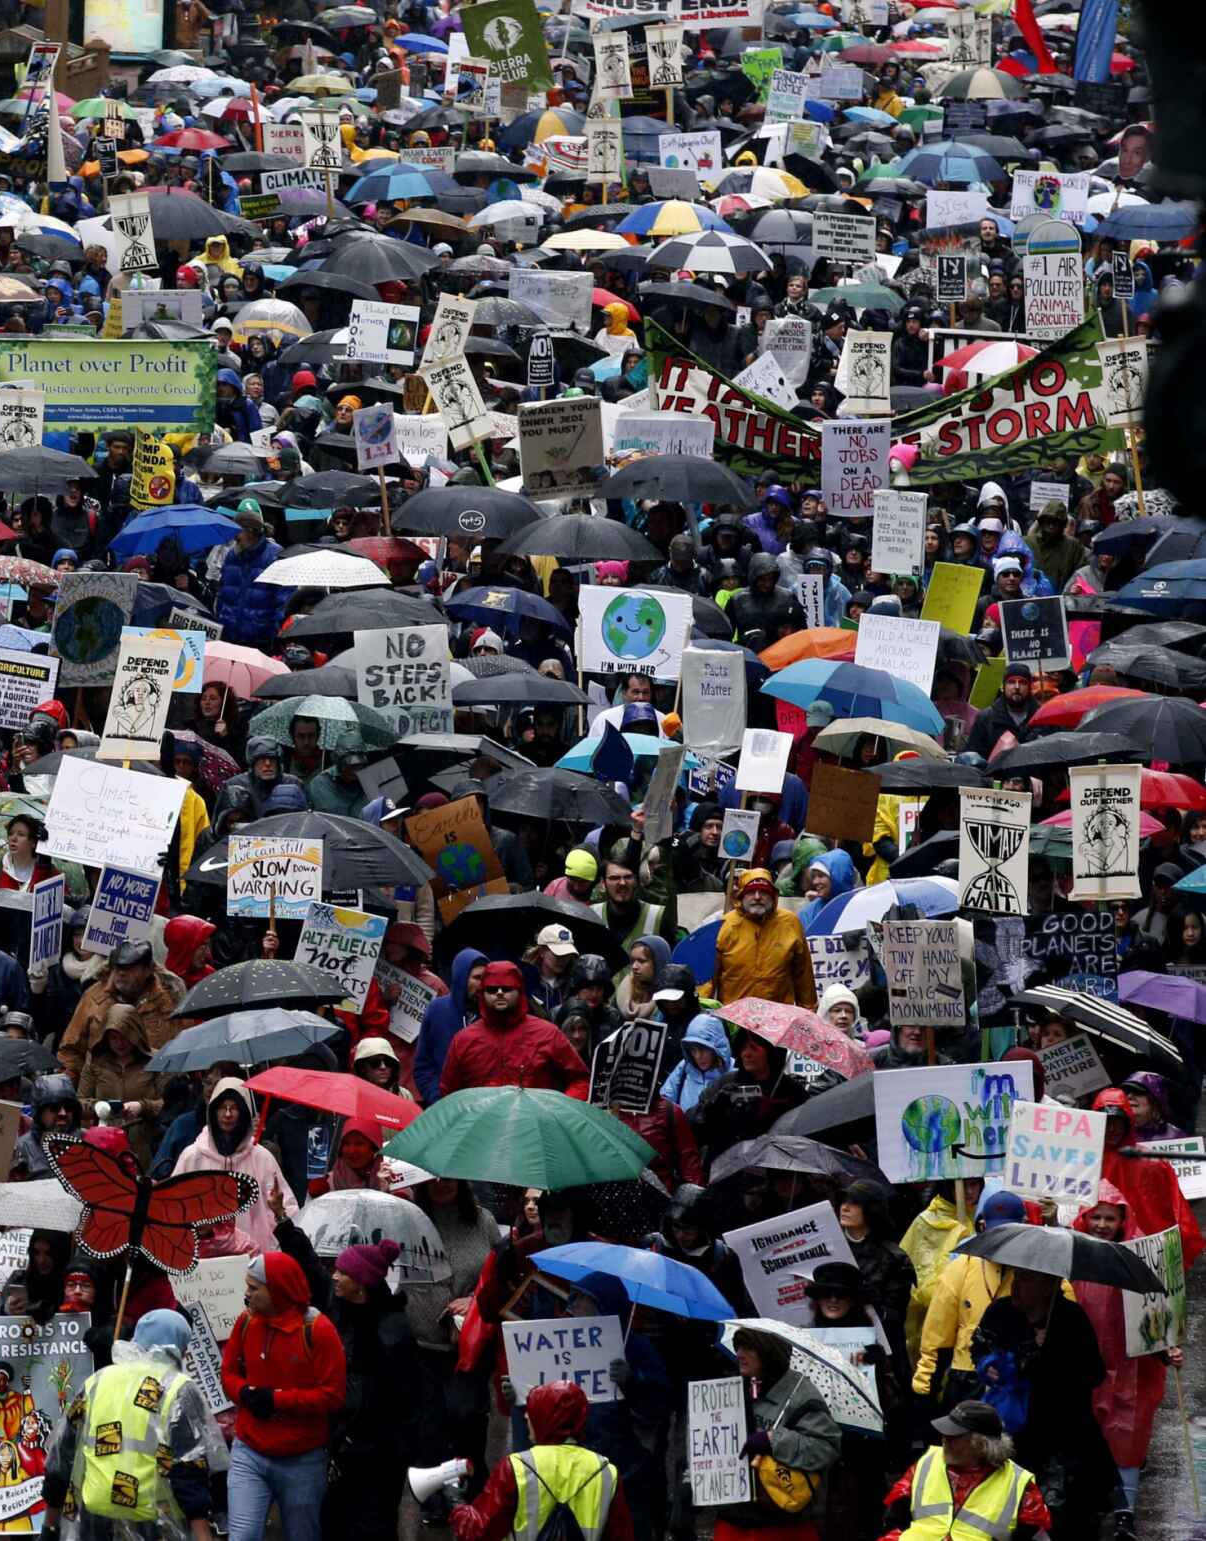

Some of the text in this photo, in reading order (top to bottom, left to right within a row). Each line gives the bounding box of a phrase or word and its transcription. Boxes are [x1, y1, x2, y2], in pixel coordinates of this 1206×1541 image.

[491, 54, 531, 74] SIERRA
[500, 67, 529, 84] CLUB
[774, 81, 803, 96] JUSTICE
[267, 173, 325, 191] CLIMATE
[1031, 256, 1078, 278] #1 AIR
[1025, 278, 1082, 298] POLLUTER?
[1029, 298, 1078, 313] ANIMAL
[1027, 312, 1082, 327] AGRICULTURE
[854, 342, 886, 351] DEFEND
[8, 353, 187, 374] Planet over Profit
[1106, 350, 1140, 363] DEFEND
[430, 363, 463, 380] DEFEND
[3, 405, 36, 414] DEFEND
[548, 426, 577, 438] MUST
[833, 426, 885, 436] THERE ARE
[938, 391, 1098, 457] STORM
[849, 434, 867, 447] NO
[838, 448, 878, 463] JOBS
[843, 467, 858, 477] ON
[841, 477, 882, 491] DEAD
[172, 613, 218, 641] BIG BANG
[386, 633, 426, 660] NO
[127, 655, 169, 669] DEFEND
[617, 662, 656, 678] WITH HER
[704, 662, 727, 677] Facts
[365, 662, 443, 687] STEPS
[372, 680, 447, 708] BACK!
[701, 682, 731, 698] Matter
[1080, 795, 1133, 807] OUR MOTHER
[1083, 787, 1130, 799] DEFEND
[281, 843, 305, 857] still
[251, 859, 317, 879] SLOW DOWN
[106, 872, 154, 899] NO MORE
[232, 880, 314, 898] WARMING
[96, 892, 151, 923] FLINTS!
[110, 917, 128, 937] Fund
[1042, 912, 1114, 933] GOOD
[888, 926, 954, 946] KEEP YOUR
[1020, 934, 1115, 956] PLANETS
[890, 948, 959, 966] TINY HANDS
[1069, 954, 1116, 975] ARE
[894, 967, 951, 984] OFF MY
[907, 986, 936, 1000] BIG
[891, 1002, 963, 1020] MONUMENTS
[628, 1026, 662, 1059] O!
[1045, 1059, 1098, 1085] FUTURE
[1033, 1106, 1093, 1139] EPA
[1010, 1163, 1093, 1198] LIVES
[751, 1219, 819, 1252] IGNORANCE
[760, 1242, 832, 1276] SCIENCE DENIAL
[210, 1272, 226, 1283] DO
[198, 1287, 235, 1300] MARCH
[189, 1306, 205, 1329] OUR
[59, 1320, 80, 1336] TO
[1, 1340, 88, 1358] RESISTANCE
[513, 1326, 604, 1355] WATER
[554, 1350, 572, 1366] IS
[693, 1383, 741, 1412] PROTECT
[711, 1412, 722, 1424] THE
[692, 1423, 740, 1458] EARTH
[693, 1469, 748, 1504] PLANET B
